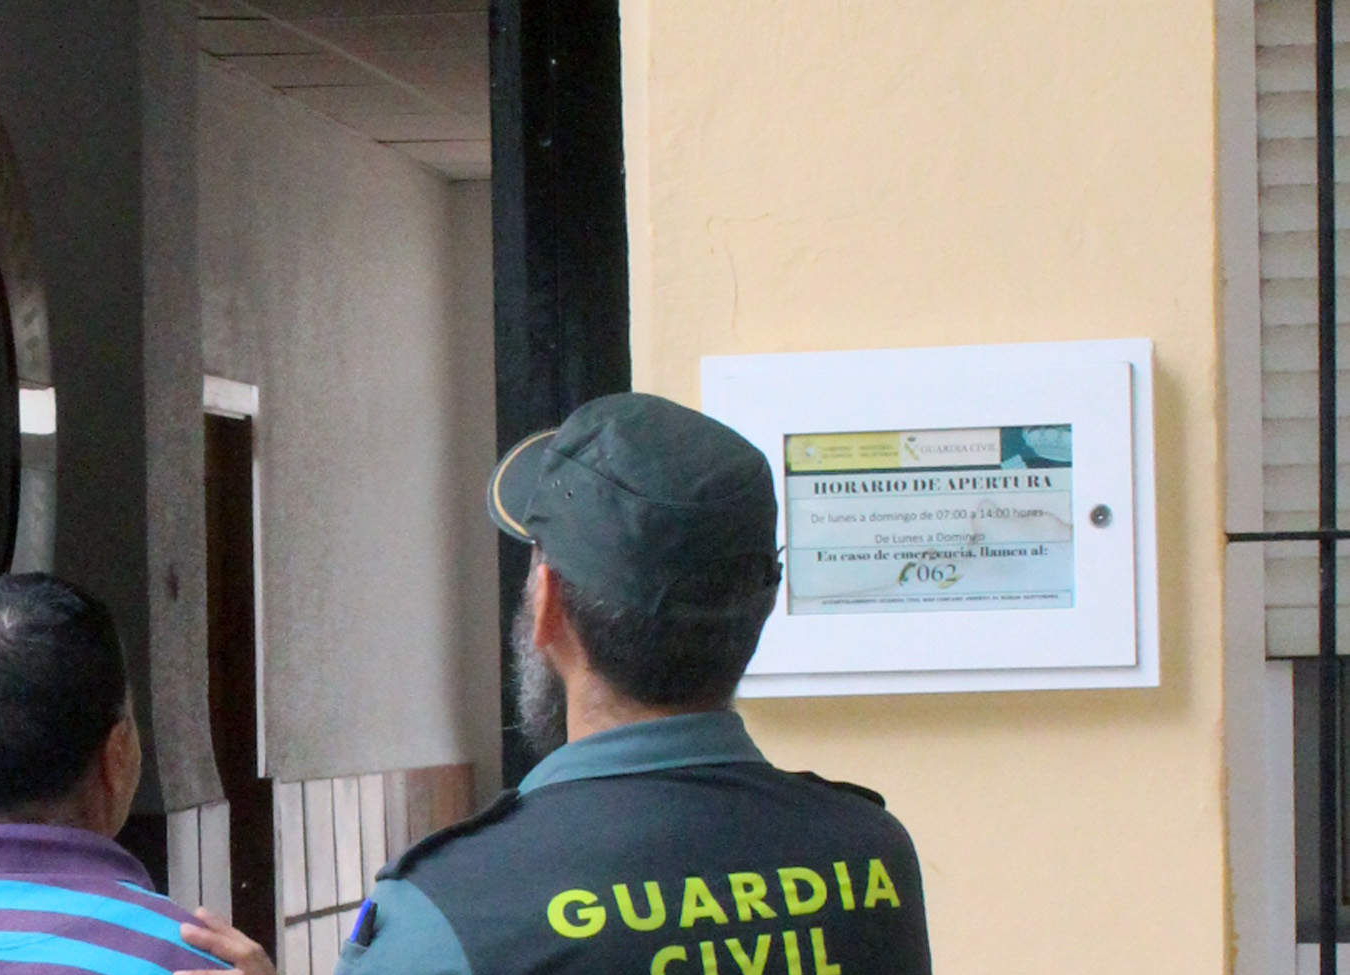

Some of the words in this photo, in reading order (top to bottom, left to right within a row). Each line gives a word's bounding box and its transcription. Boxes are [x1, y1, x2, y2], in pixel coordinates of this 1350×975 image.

[919, 443, 968, 455] GUARDIA
[969, 441, 998, 453] CIVIL
[813, 480, 908, 495] HORARIO
[912, 478, 942, 492] DE
[947, 474, 1053, 490] APERTURA
[810, 513, 825, 524] De
[828, 513, 857, 523] lunes
[859, 514, 866, 522] a
[869, 511, 917, 524] domingo
[920, 509, 934, 521] de
[935, 508, 967, 520] 07:00
[980, 507, 1010, 519] 14:00
[874, 534, 889, 544] De
[892, 533, 924, 544] Lunes
[927, 533, 933, 542] a
[935, 531, 986, 544] Domingo
[817, 551, 837, 562] En
[840, 551, 871, 561] caso
[873, 549, 890, 561] de
[979, 546, 1027, 558] llamen
[1030, 544, 1049, 557] al:
[916, 563, 957, 582] 062
[547, 858, 901, 939] GUARDIA
